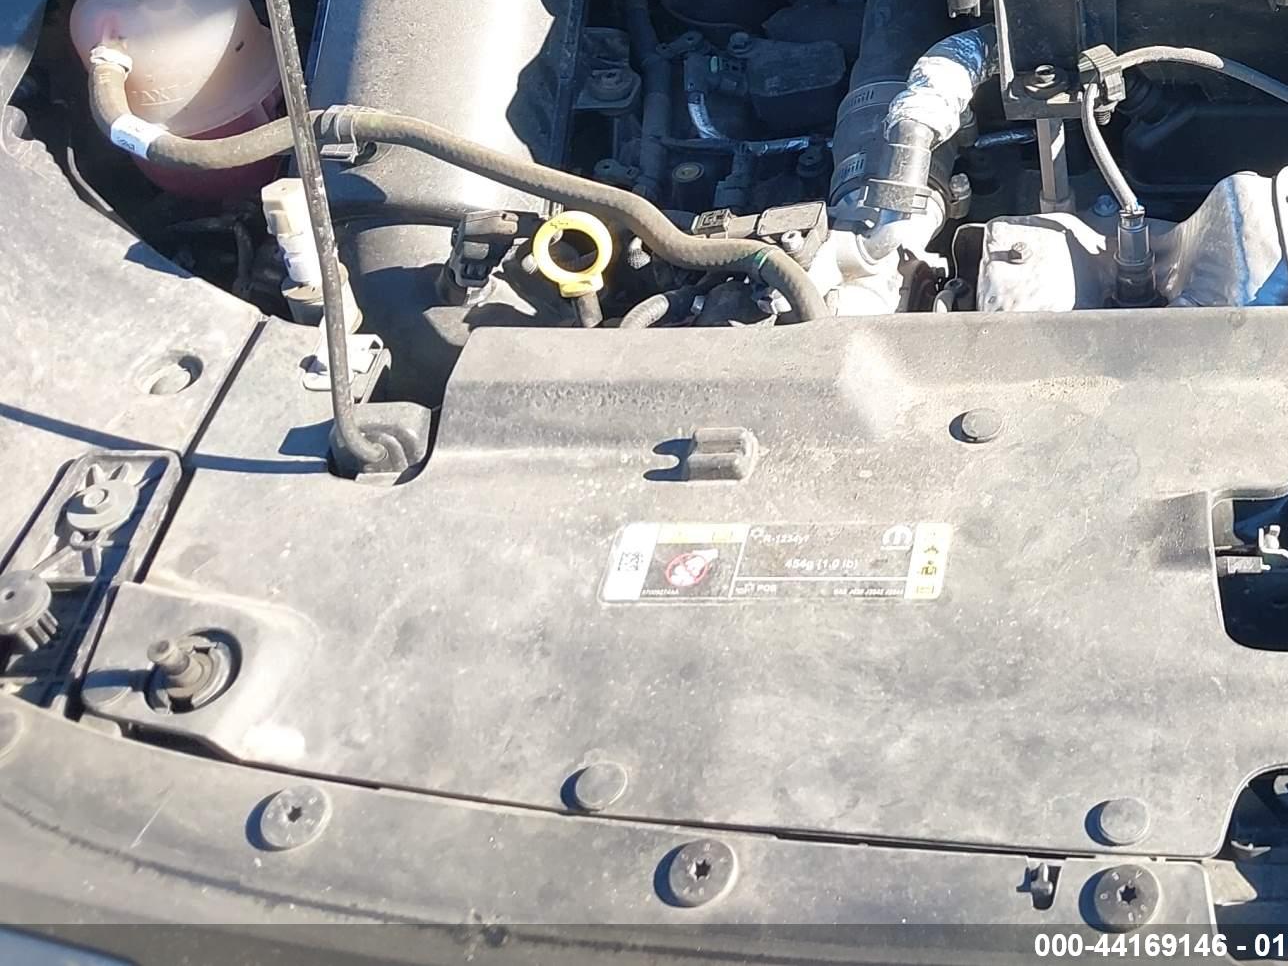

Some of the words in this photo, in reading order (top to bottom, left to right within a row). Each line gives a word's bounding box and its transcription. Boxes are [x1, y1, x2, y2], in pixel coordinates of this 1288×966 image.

[784, 559, 814, 571] 454g
[816, 558, 841, 572] (1.0
[842, 558, 859, 572] lb)
